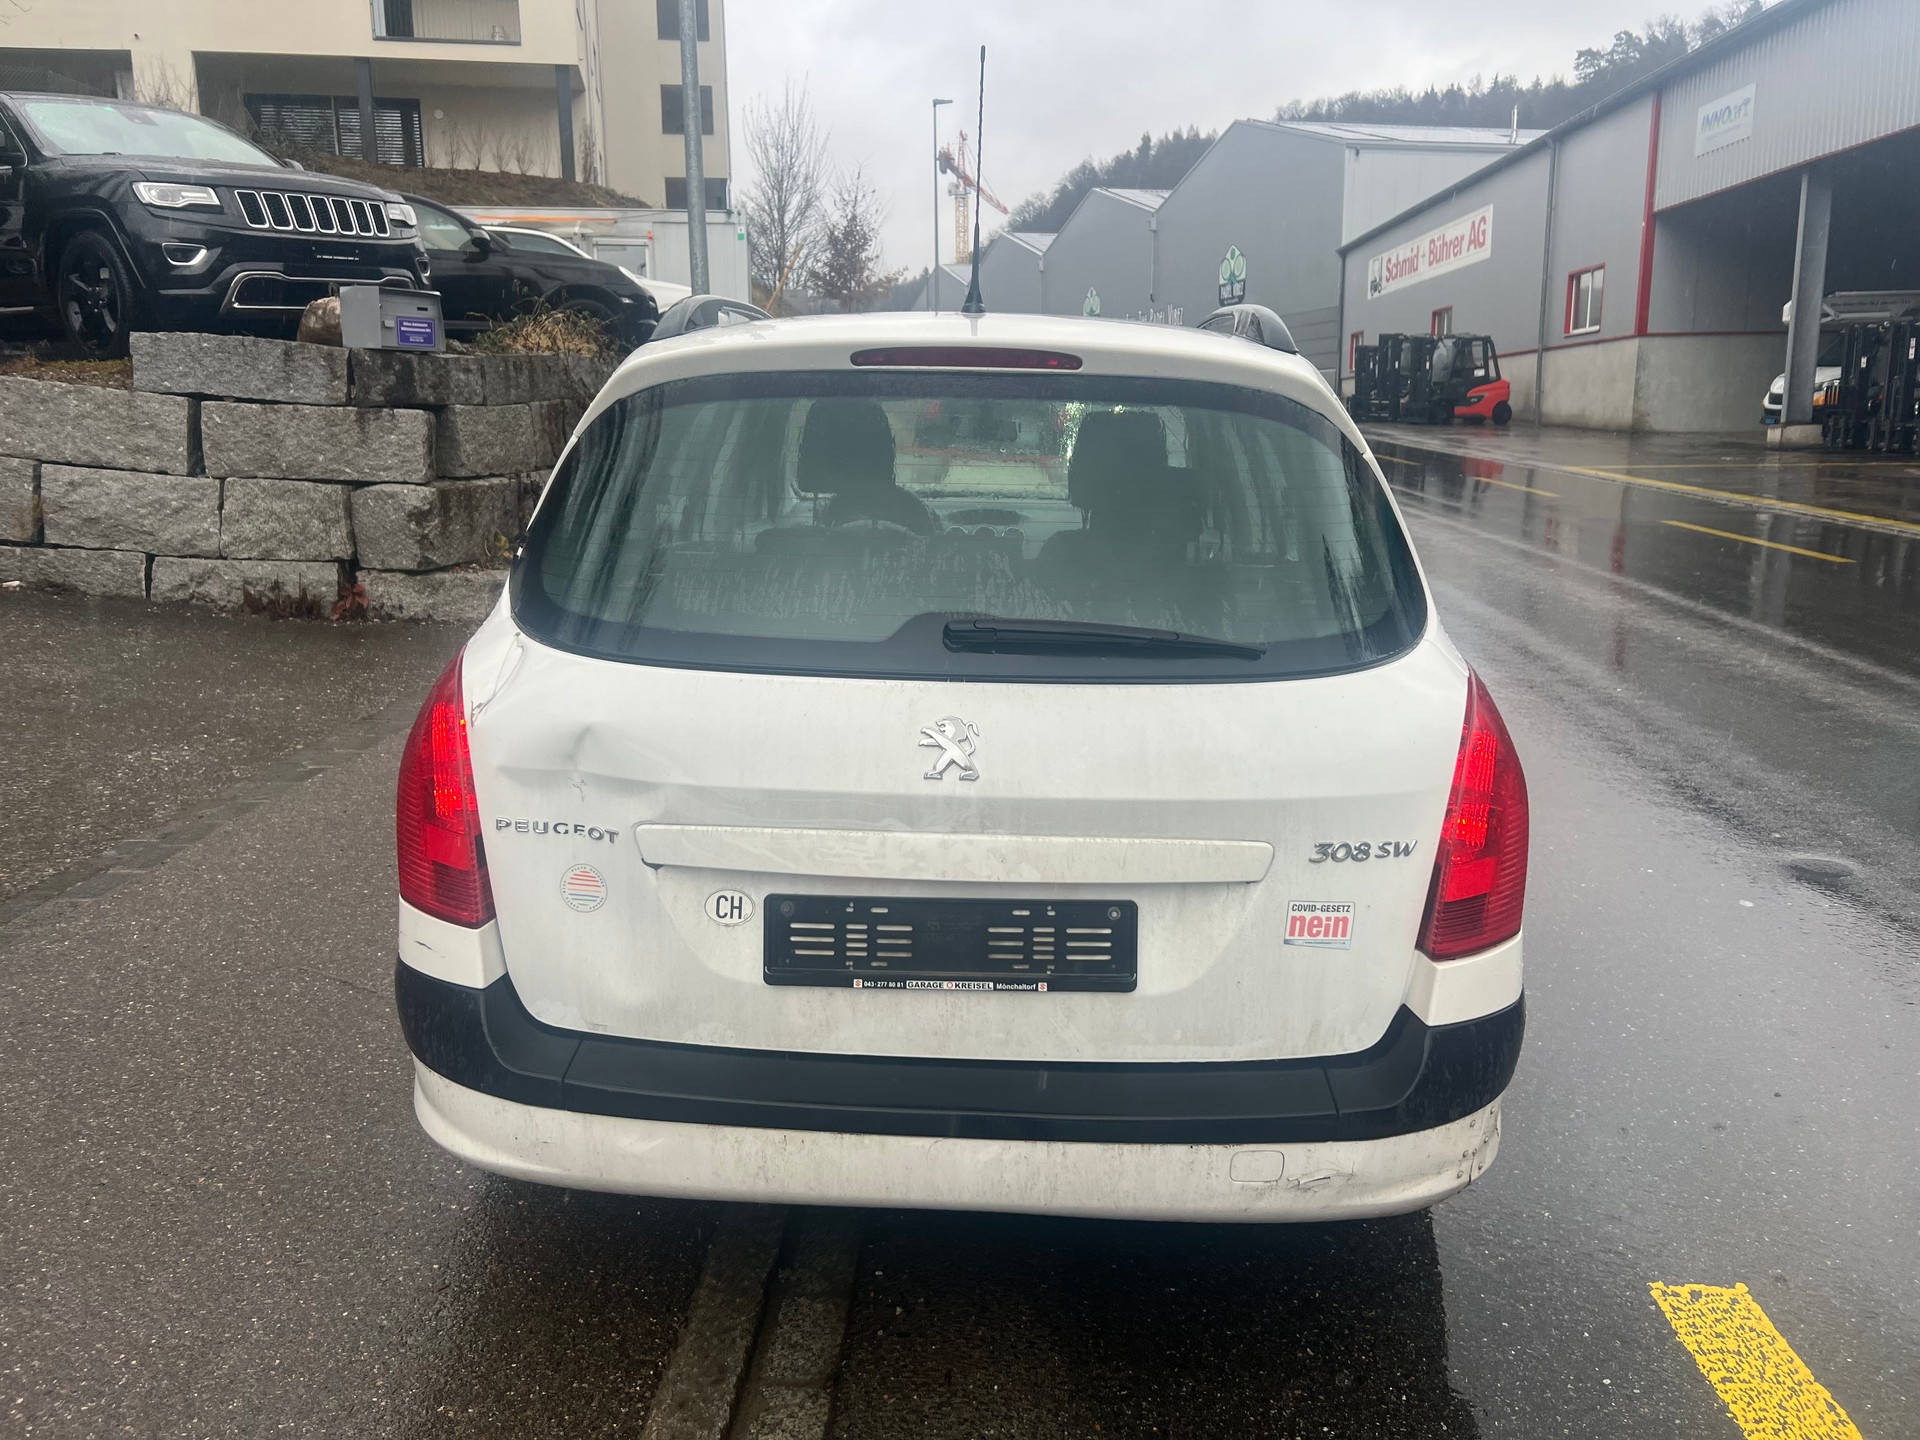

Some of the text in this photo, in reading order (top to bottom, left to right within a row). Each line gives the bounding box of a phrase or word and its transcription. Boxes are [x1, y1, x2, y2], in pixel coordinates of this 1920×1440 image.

[1385, 245, 1420, 284] Schmid
[1428, 233, 1464, 267] Bührer
[1467, 214, 1487, 253] AG
[495, 816, 620, 844] PEUGEOT
[1308, 839, 1418, 864] 308 SW
[715, 894, 743, 920] CH
[1291, 903, 1351, 913] COVID-GESETZ
[1288, 915, 1350, 938] nein
[907, 981, 944, 989] GARAGE
[954, 982, 993, 990] KREISEL
